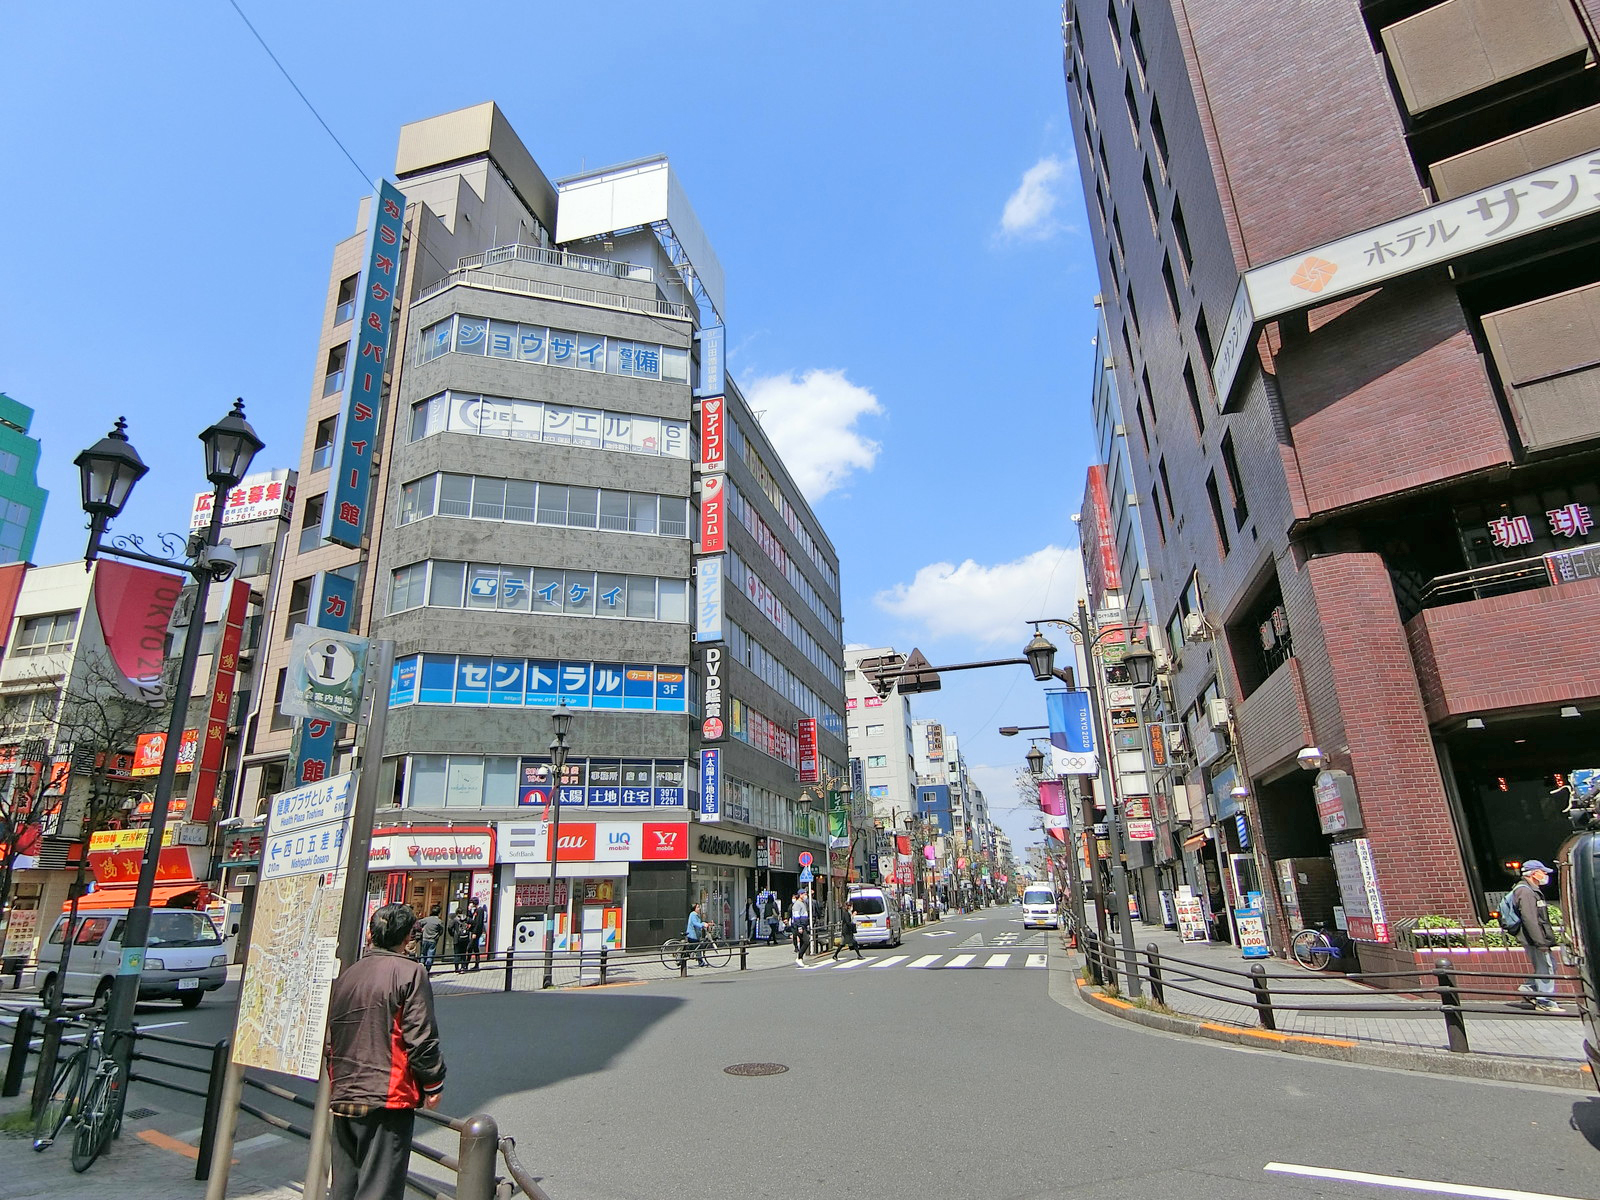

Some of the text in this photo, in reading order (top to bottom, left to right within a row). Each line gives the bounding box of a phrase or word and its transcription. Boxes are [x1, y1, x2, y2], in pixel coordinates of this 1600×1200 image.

[1364, 158, 1600, 267] ホテル サン
[549, 410, 630, 437] シエル
[706, 413, 721, 460] アイフル
[195, 482, 282, 512] 広生募集
[193, 519, 208, 527] TEL
[706, 502, 719, 535] アコム
[1487, 503, 1595, 549] 珈琲
[707, 538, 718, 547] 5F
[504, 577, 626, 606] テイケイ
[701, 577, 717, 628] テイケイ
[461, 662, 621, 693] セントラル
[631, 671, 679, 681] カードローン
[705, 648, 721, 717] DVD鑑賞
[662, 684, 678, 695] 3F
[1079, 707, 1091, 749] TOKYO 2020
[655, 771, 683, 782] 不動産
[705, 757, 715, 813] 太陽土地住宅
[277, 786, 334, 817] 健康プラザとしま
[660, 788, 679, 797] 3971
[660, 796, 679, 805] 2291
[280, 816, 294, 827] Health
[294, 813, 305, 824] Plaza
[306, 808, 325, 821] Toshima
[283, 828, 345, 858] 西口五差路
[557, 834, 588, 849] au
[608, 832, 631, 846] UQ
[652, 830, 678, 846] Y!
[290, 855, 313, 869] Nishiguchi
[313, 854, 330, 866] Gosaro
[420, 844, 482, 857] vape studio
[508, 850, 535, 858] SoftBank
